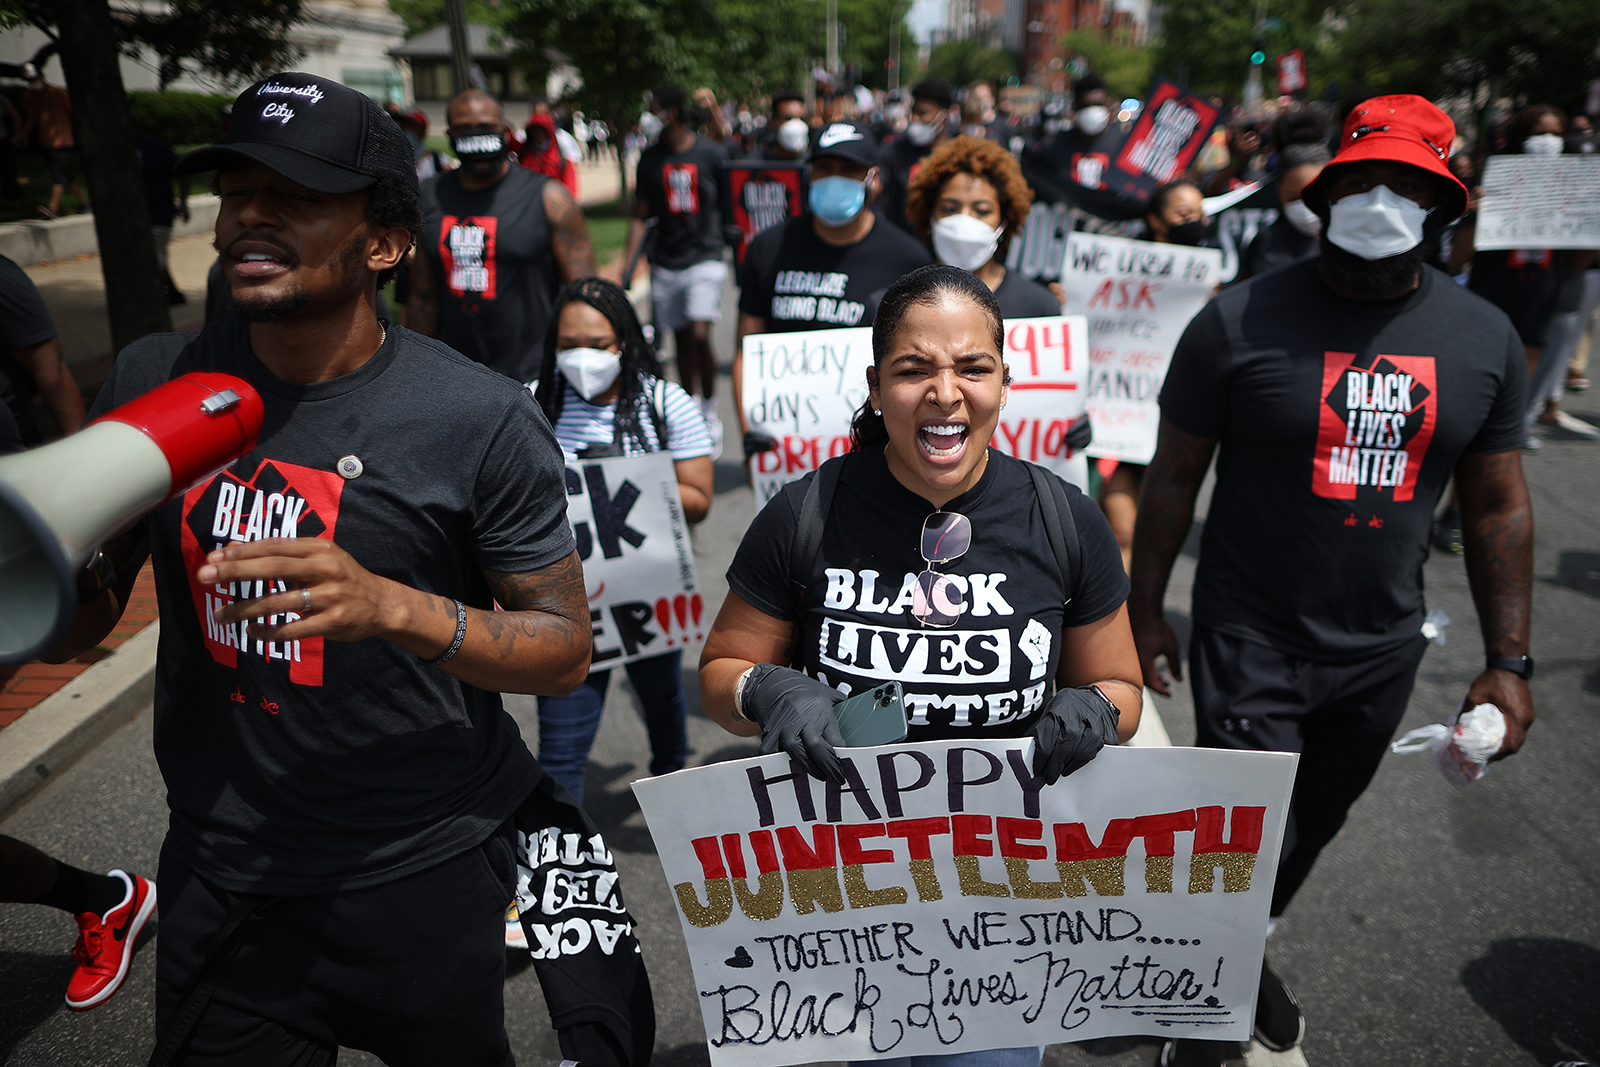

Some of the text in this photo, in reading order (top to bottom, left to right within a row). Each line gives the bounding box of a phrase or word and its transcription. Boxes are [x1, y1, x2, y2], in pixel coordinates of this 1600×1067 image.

[256, 82, 324, 103] University
[263, 102, 294, 124] City
[775, 271, 849, 297] LEGALIZE
[1087, 278, 1162, 311] ASK
[772, 297, 817, 321] BEING
[749, 339, 851, 395] today
[750, 387, 818, 434] days
[1346, 371, 1413, 413] BLACK
[1345, 410, 1407, 450] LIVES
[1328, 446, 1409, 487] MATTER
[212, 481, 305, 543] BLACK
[823, 568, 1015, 617] BLACK
[825, 623, 999, 676] LIVES
[746, 747, 1047, 827] HAPPY
[674, 805, 1267, 928] JUNETEENTH
[754, 921, 923, 972] TOGETHER
[701, 967, 904, 1054] Black
[896, 958, 1029, 1045] Lives
